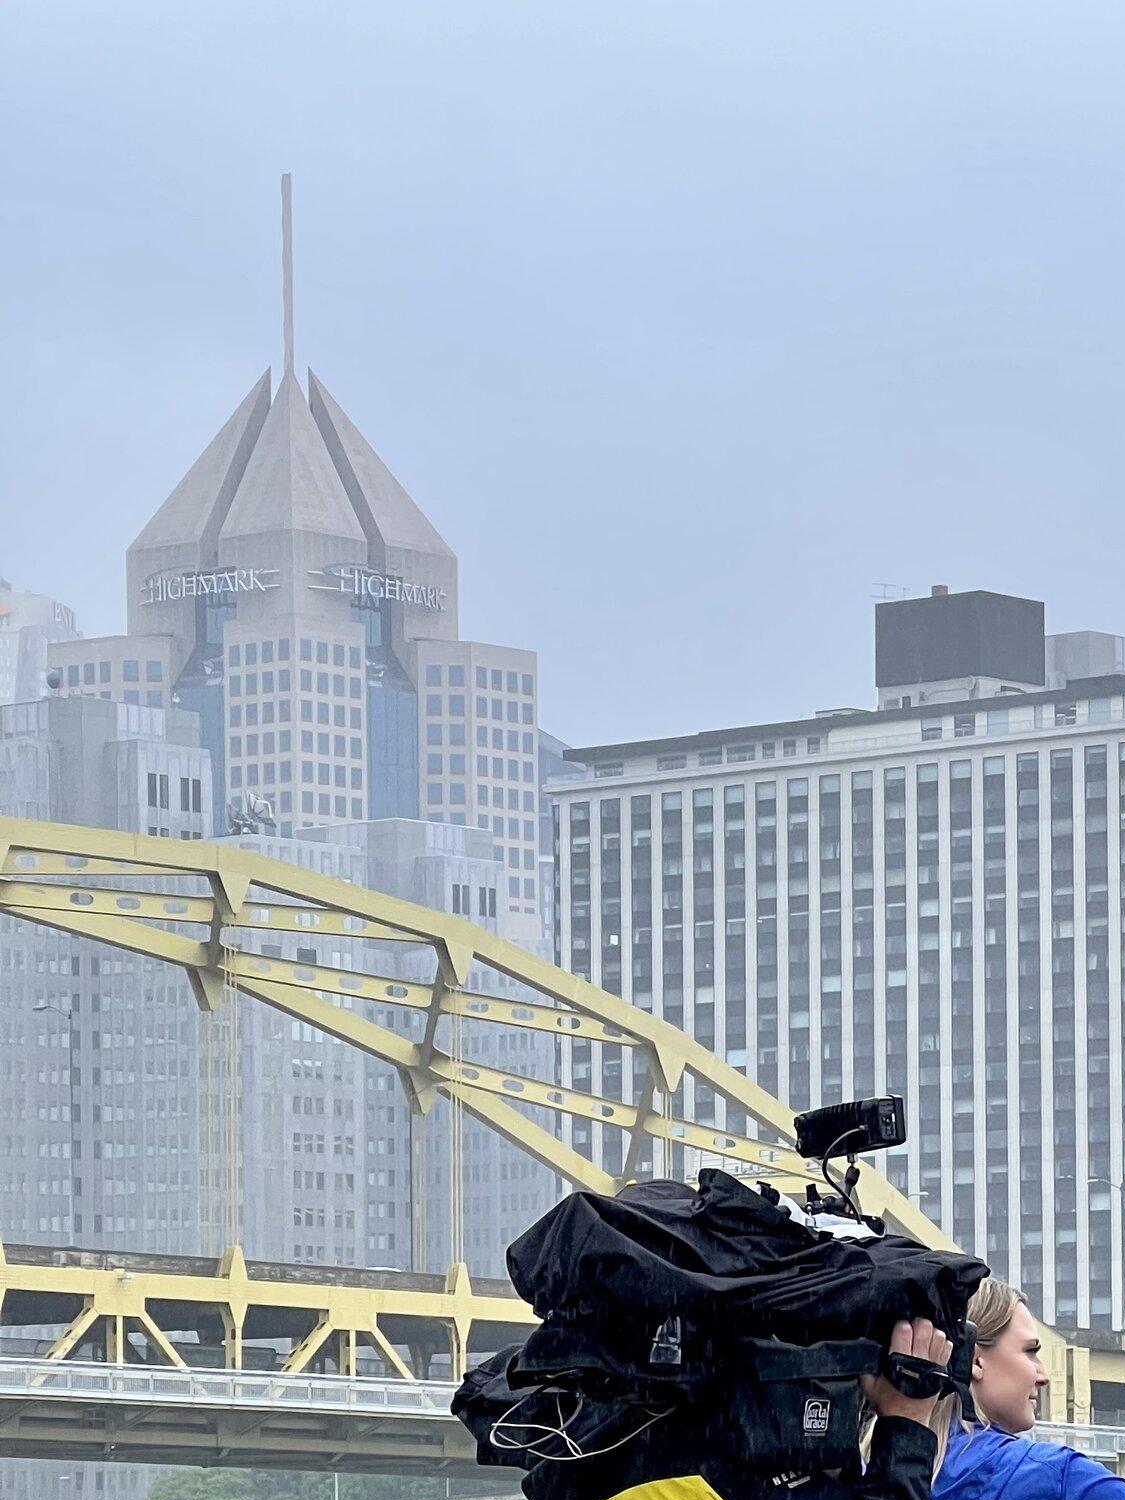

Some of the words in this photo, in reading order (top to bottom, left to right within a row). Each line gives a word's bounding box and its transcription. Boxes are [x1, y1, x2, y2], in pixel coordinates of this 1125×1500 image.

[150, 568, 266, 603] HIGHMARK
[340, 567, 446, 610] HIGHMARK
[772, 1470, 803, 1486] HEA
